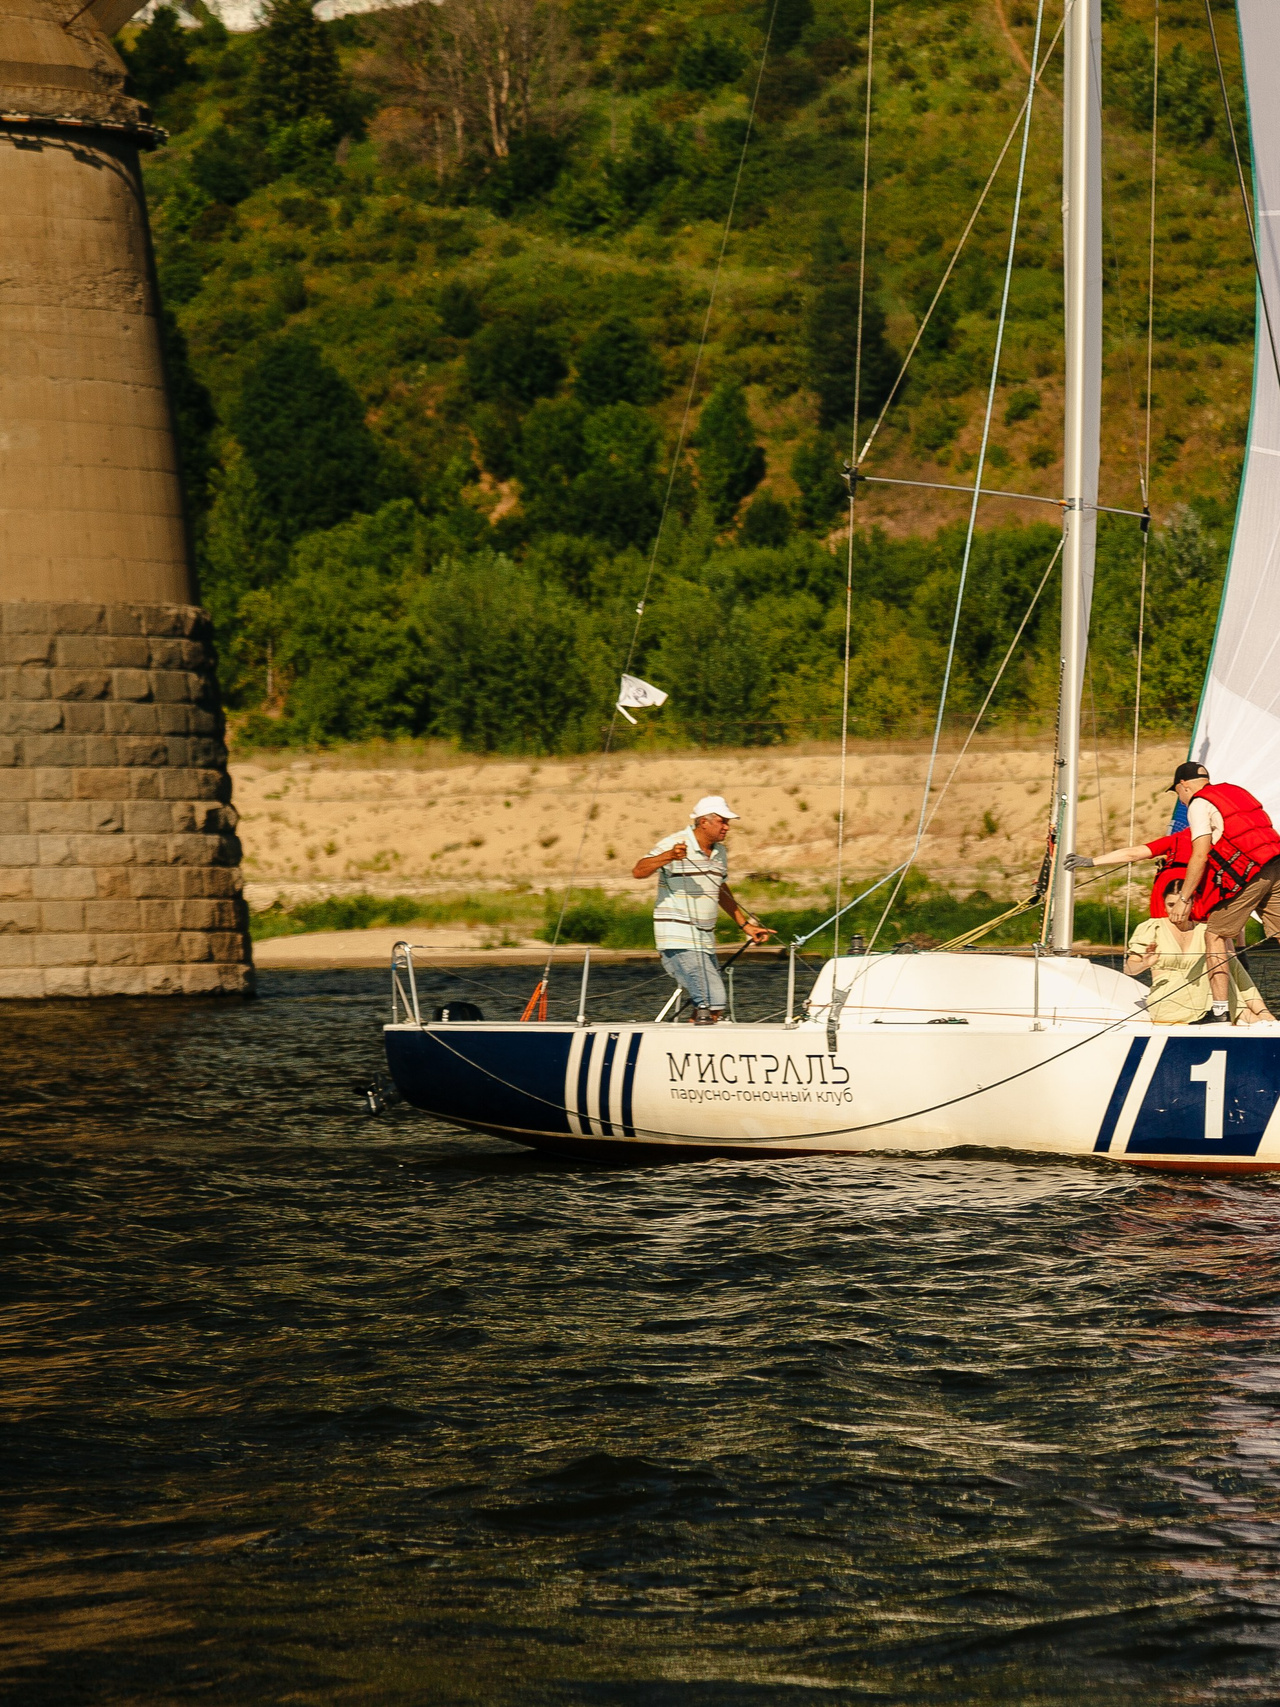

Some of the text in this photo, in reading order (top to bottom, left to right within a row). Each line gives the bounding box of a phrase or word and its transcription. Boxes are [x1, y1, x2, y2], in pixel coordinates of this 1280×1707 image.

[666, 1052, 850, 1085] МИСТРАЛЬ
[670, 1087, 853, 1106] парусно-гоночный клуб
[1190, 1050, 1227, 1139] 1
